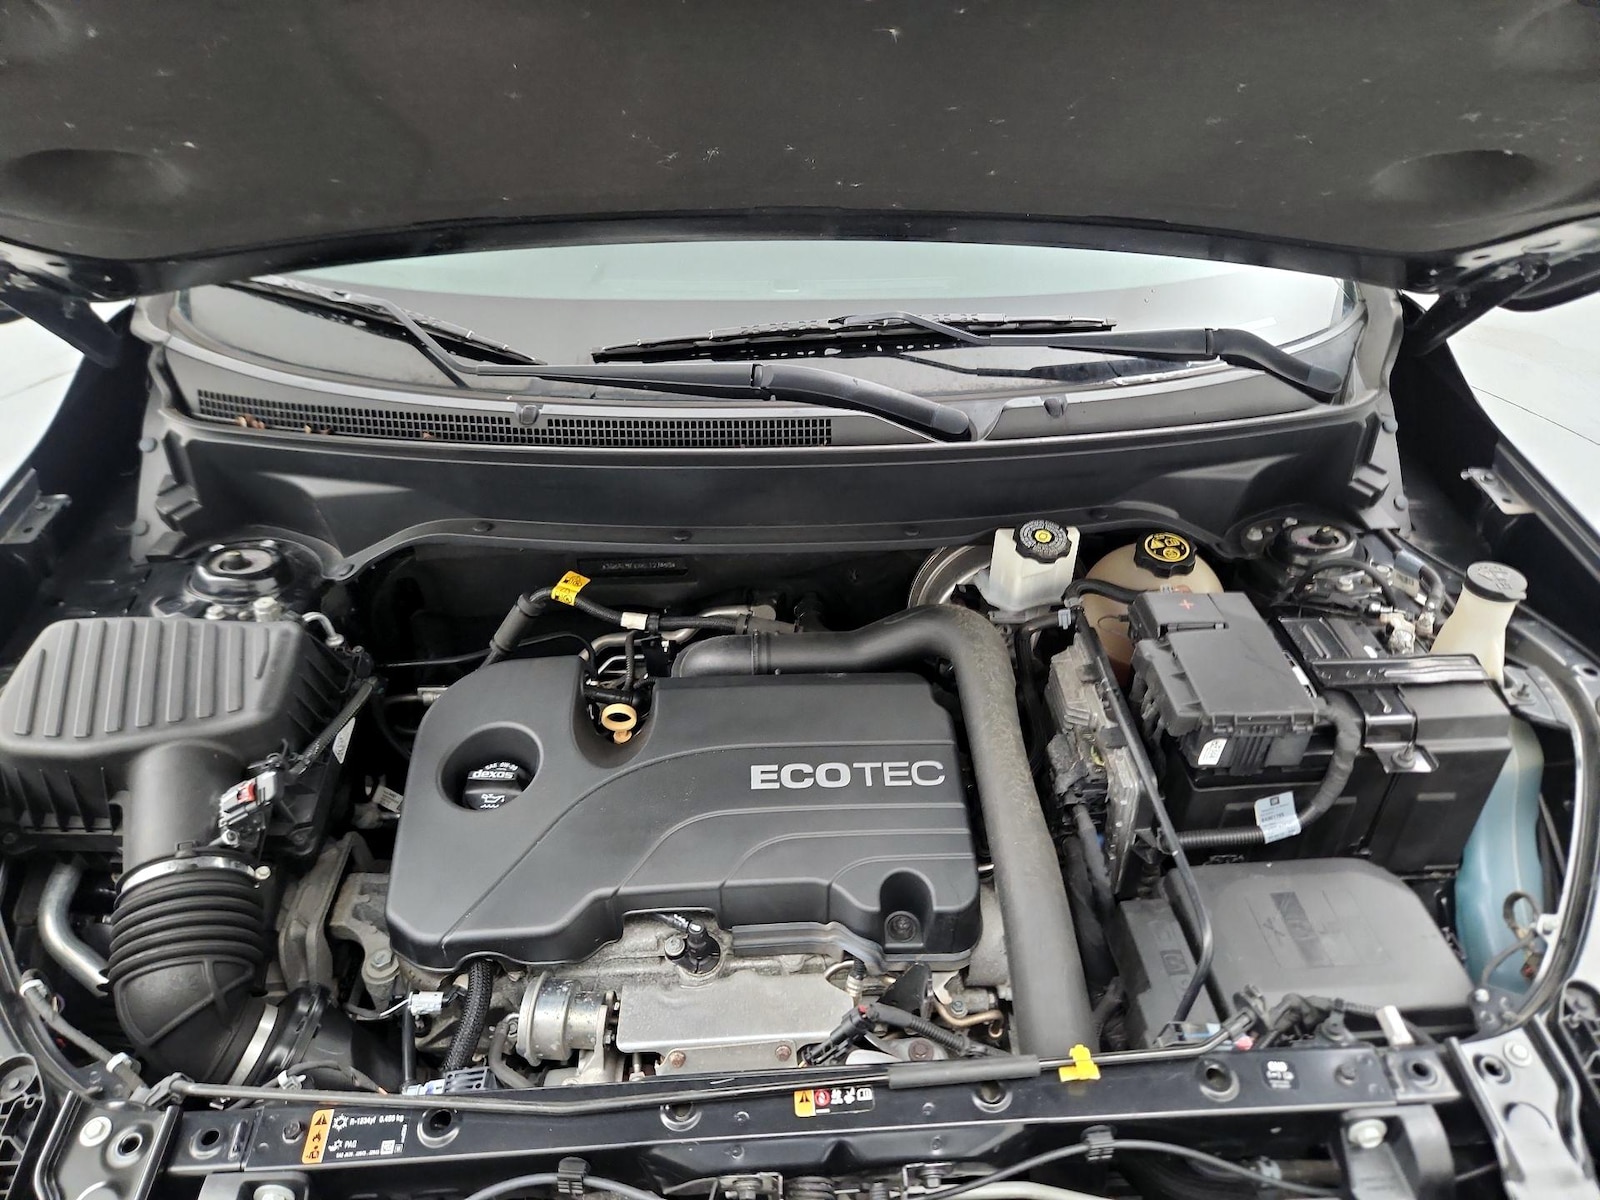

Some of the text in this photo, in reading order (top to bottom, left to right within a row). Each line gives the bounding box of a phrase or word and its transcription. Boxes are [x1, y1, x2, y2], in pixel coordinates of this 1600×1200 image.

[472, 769, 514, 779] dexos
[750, 760, 945, 790] ECOTEC
[344, 1139, 357, 1149] PAG
